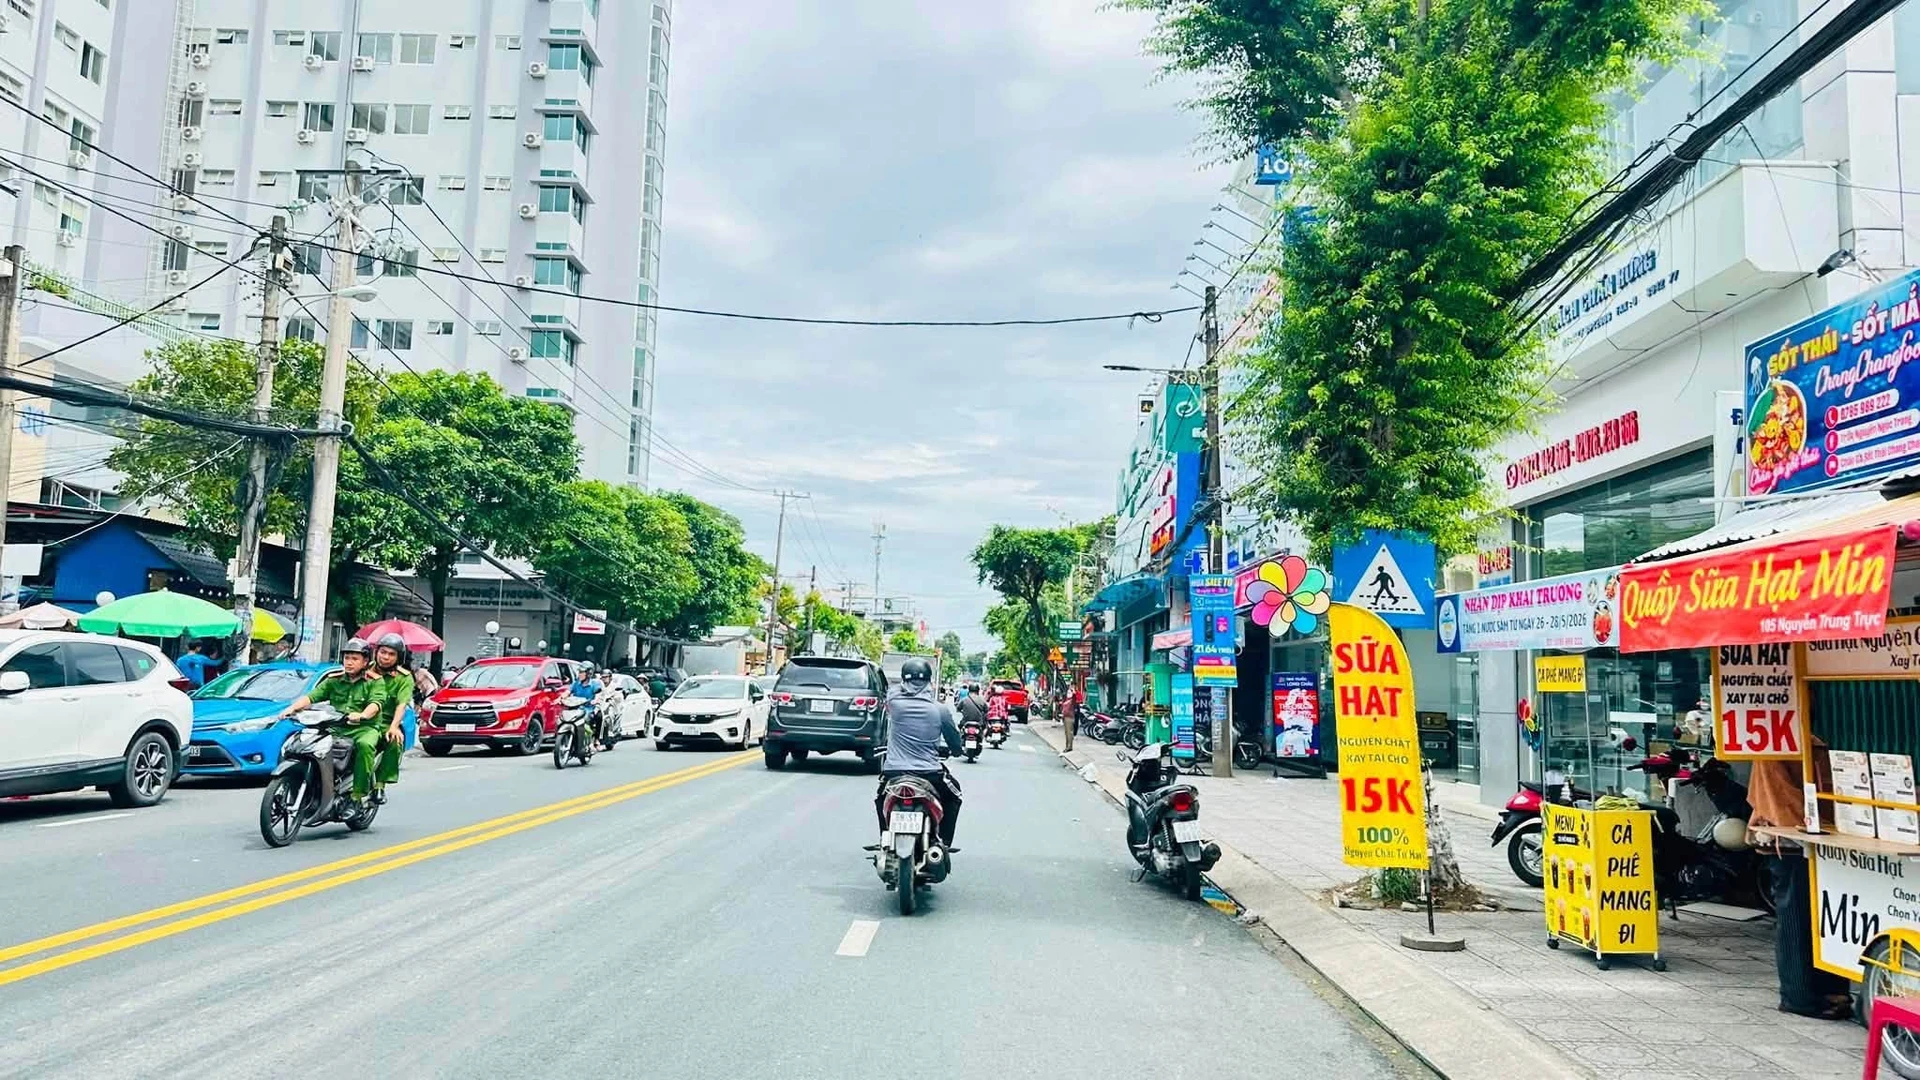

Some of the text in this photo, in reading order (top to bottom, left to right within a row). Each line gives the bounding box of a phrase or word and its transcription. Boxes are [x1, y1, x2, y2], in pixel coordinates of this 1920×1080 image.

[1768, 338, 1800, 377] SỐT
[1801, 325, 1838, 364] THÁI
[1852, 300, 1888, 346] SỐT
[1876, 393, 1891, 409] 222
[1623, 543, 1886, 630] Quầy Sữa Hạt Min
[1508, 590, 1534, 609] KHAI
[1536, 616, 1545, 629] 26
[1778, 614, 1817, 635] Nguyễn
[1819, 613, 1851, 632] Trung
[1854, 611, 1881, 630] Trực
[1335, 635, 1400, 676] SỮA
[1757, 642, 1791, 673] HẠT
[1889, 654, 1910, 670] Xay
[1558, 667, 1577, 683] MANG
[1721, 669, 1793, 687] NGUYÊN CHẤT
[1339, 685, 1403, 723] HẠT
[1726, 688, 1789, 707] XAY TẠI CHỖ
[1722, 709, 1798, 752] 15K
[1346, 753, 1366, 764] XAY
[1342, 777, 1415, 815] 15K
[1555, 814, 1575, 831] MENU
[1611, 819, 1633, 845] CÀ
[1357, 826, 1410, 846] 100%
[1607, 853, 1640, 878] PHÊ
[1849, 848, 1875, 872] Sữa
[1877, 854, 1904, 880] Hạt
[1600, 890, 1651, 911] MANG
[1893, 887, 1916, 904] Chọn
[1820, 890, 1880, 947] Min
[1887, 904, 1910, 922] Chọn
[1618, 923, 1636, 944] ĐI
